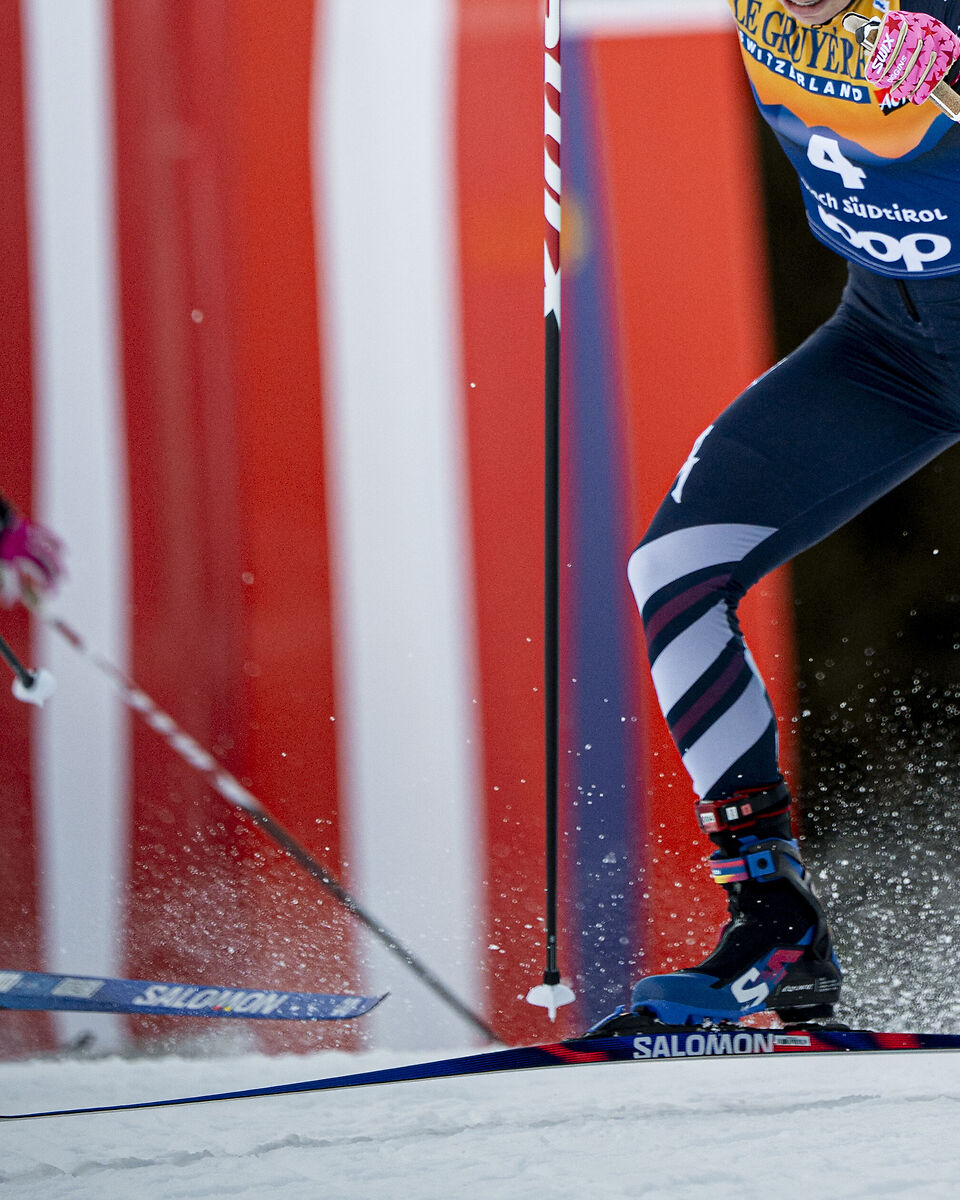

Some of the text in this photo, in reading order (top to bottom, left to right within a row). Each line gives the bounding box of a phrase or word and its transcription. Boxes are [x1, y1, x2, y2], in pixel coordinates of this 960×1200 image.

[871, 32, 895, 75] SWIX
[807, 134, 867, 189] 4
[131, 984, 289, 1015] SALOMON
[632, 1033, 775, 1060] SALOMON
